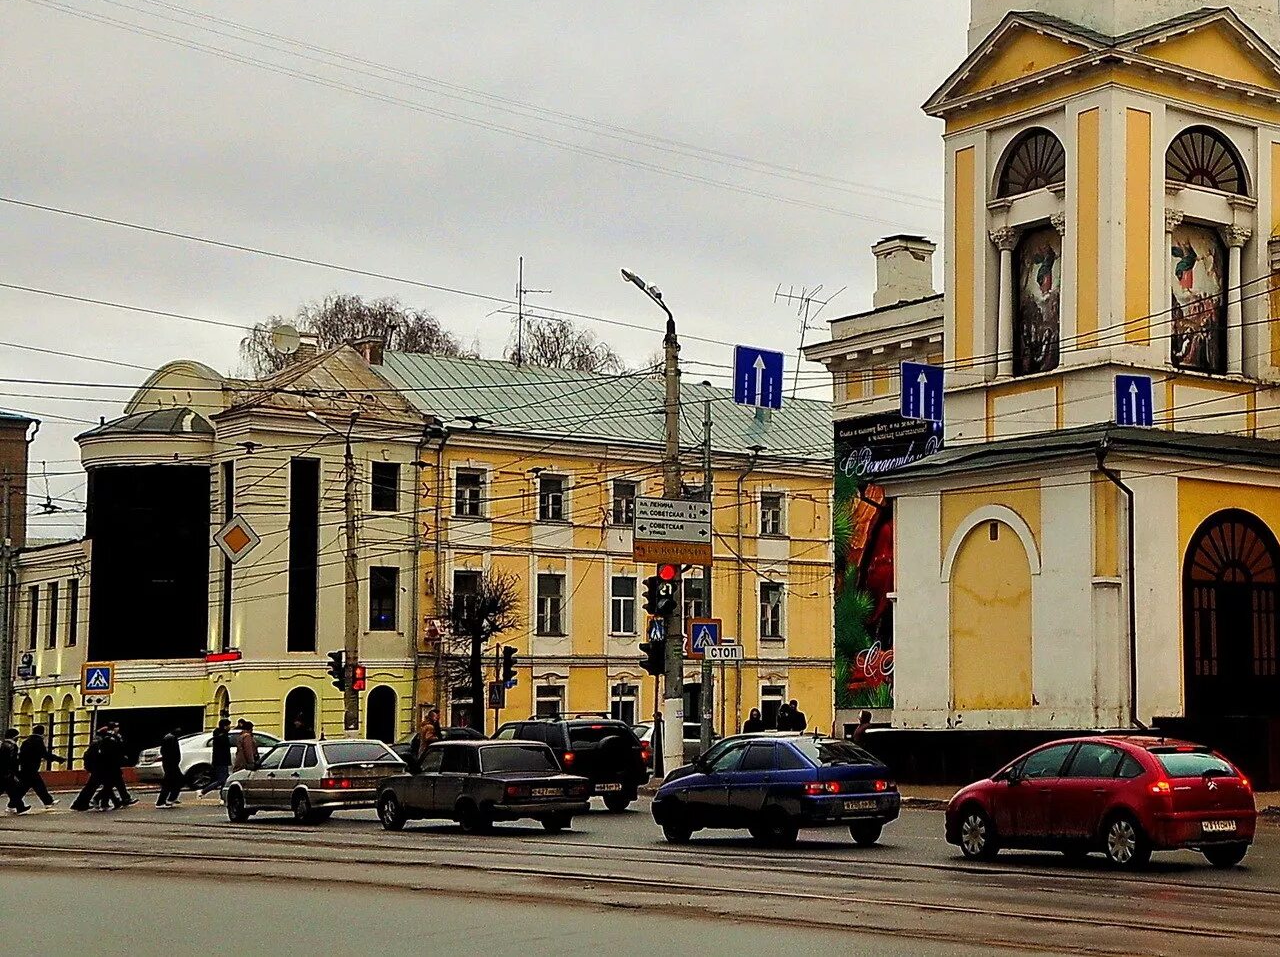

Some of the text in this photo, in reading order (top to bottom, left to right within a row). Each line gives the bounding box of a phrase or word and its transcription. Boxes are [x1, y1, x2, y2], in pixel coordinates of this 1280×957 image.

[649, 501, 674, 510] ЛЕНИНА
[649, 510, 685, 519] СОВЕТСКАЯ
[649, 522, 684, 531] СОВЕТСКАЯ
[710, 647, 737, 658] СТОП
